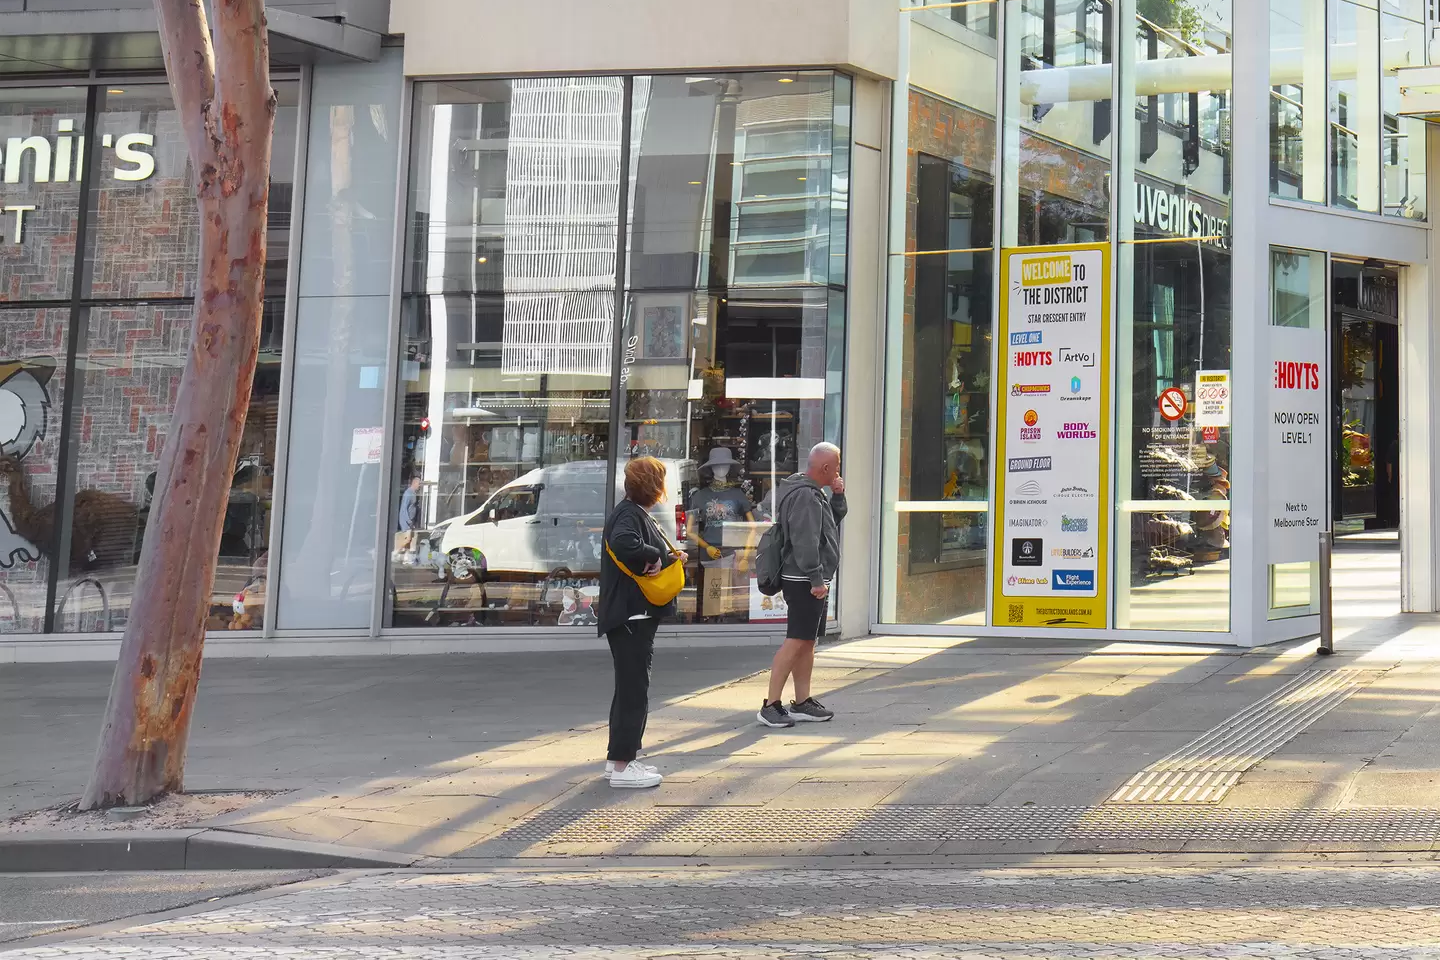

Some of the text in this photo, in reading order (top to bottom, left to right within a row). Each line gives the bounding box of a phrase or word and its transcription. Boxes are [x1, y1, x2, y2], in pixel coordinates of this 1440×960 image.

[1133, 181, 1231, 250] uvenirs DIREC
[1023, 259, 1086, 281] WELCOME TO
[1023, 286, 1088, 305] THE DISTRICT
[1028, 312, 1086, 324] STAR CRESCENT ENTRY
[1012, 332, 1041, 344] LEVEL ONE
[1017, 351, 1052, 367] HOYTS
[1064, 352, 1090, 362] ArtVo
[1278, 361, 1319, 390] HOYTS
[1274, 412, 1319, 425] NOW OPEN
[1063, 423, 1089, 431] BODY
[1057, 430, 1096, 439] WORLDS
[1282, 432, 1312, 444] LEVEL 1
[1009, 457, 1051, 471] GROUND FLOOR
[1285, 502, 1308, 511] Next to
[1274, 517, 1319, 528] Melbourne Star
[1063, 548, 1081, 556] BUILDERS
